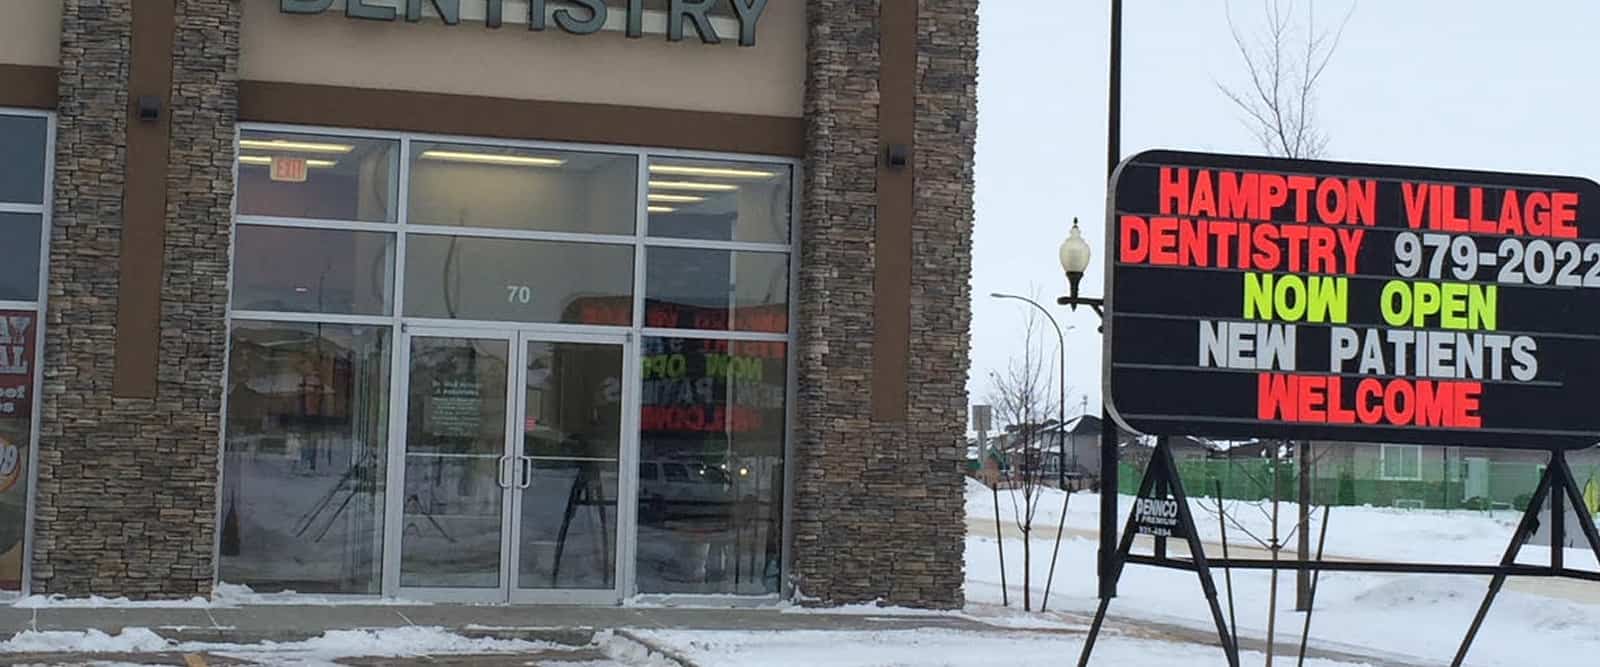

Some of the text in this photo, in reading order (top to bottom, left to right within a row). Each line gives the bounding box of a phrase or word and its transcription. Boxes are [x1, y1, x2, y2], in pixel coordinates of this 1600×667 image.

[1159, 166, 1578, 239] HAMPTON VILLAGE
[1120, 215, 1600, 287] DENTISTRY 979-2022
[507, 286, 530, 304] 70
[1243, 272, 1497, 331] NOW OPEN
[1199, 321, 1538, 381] NEW PATIENTS
[1257, 373, 1482, 428] WELCOME
[1136, 498, 1178, 522] PENNCO
